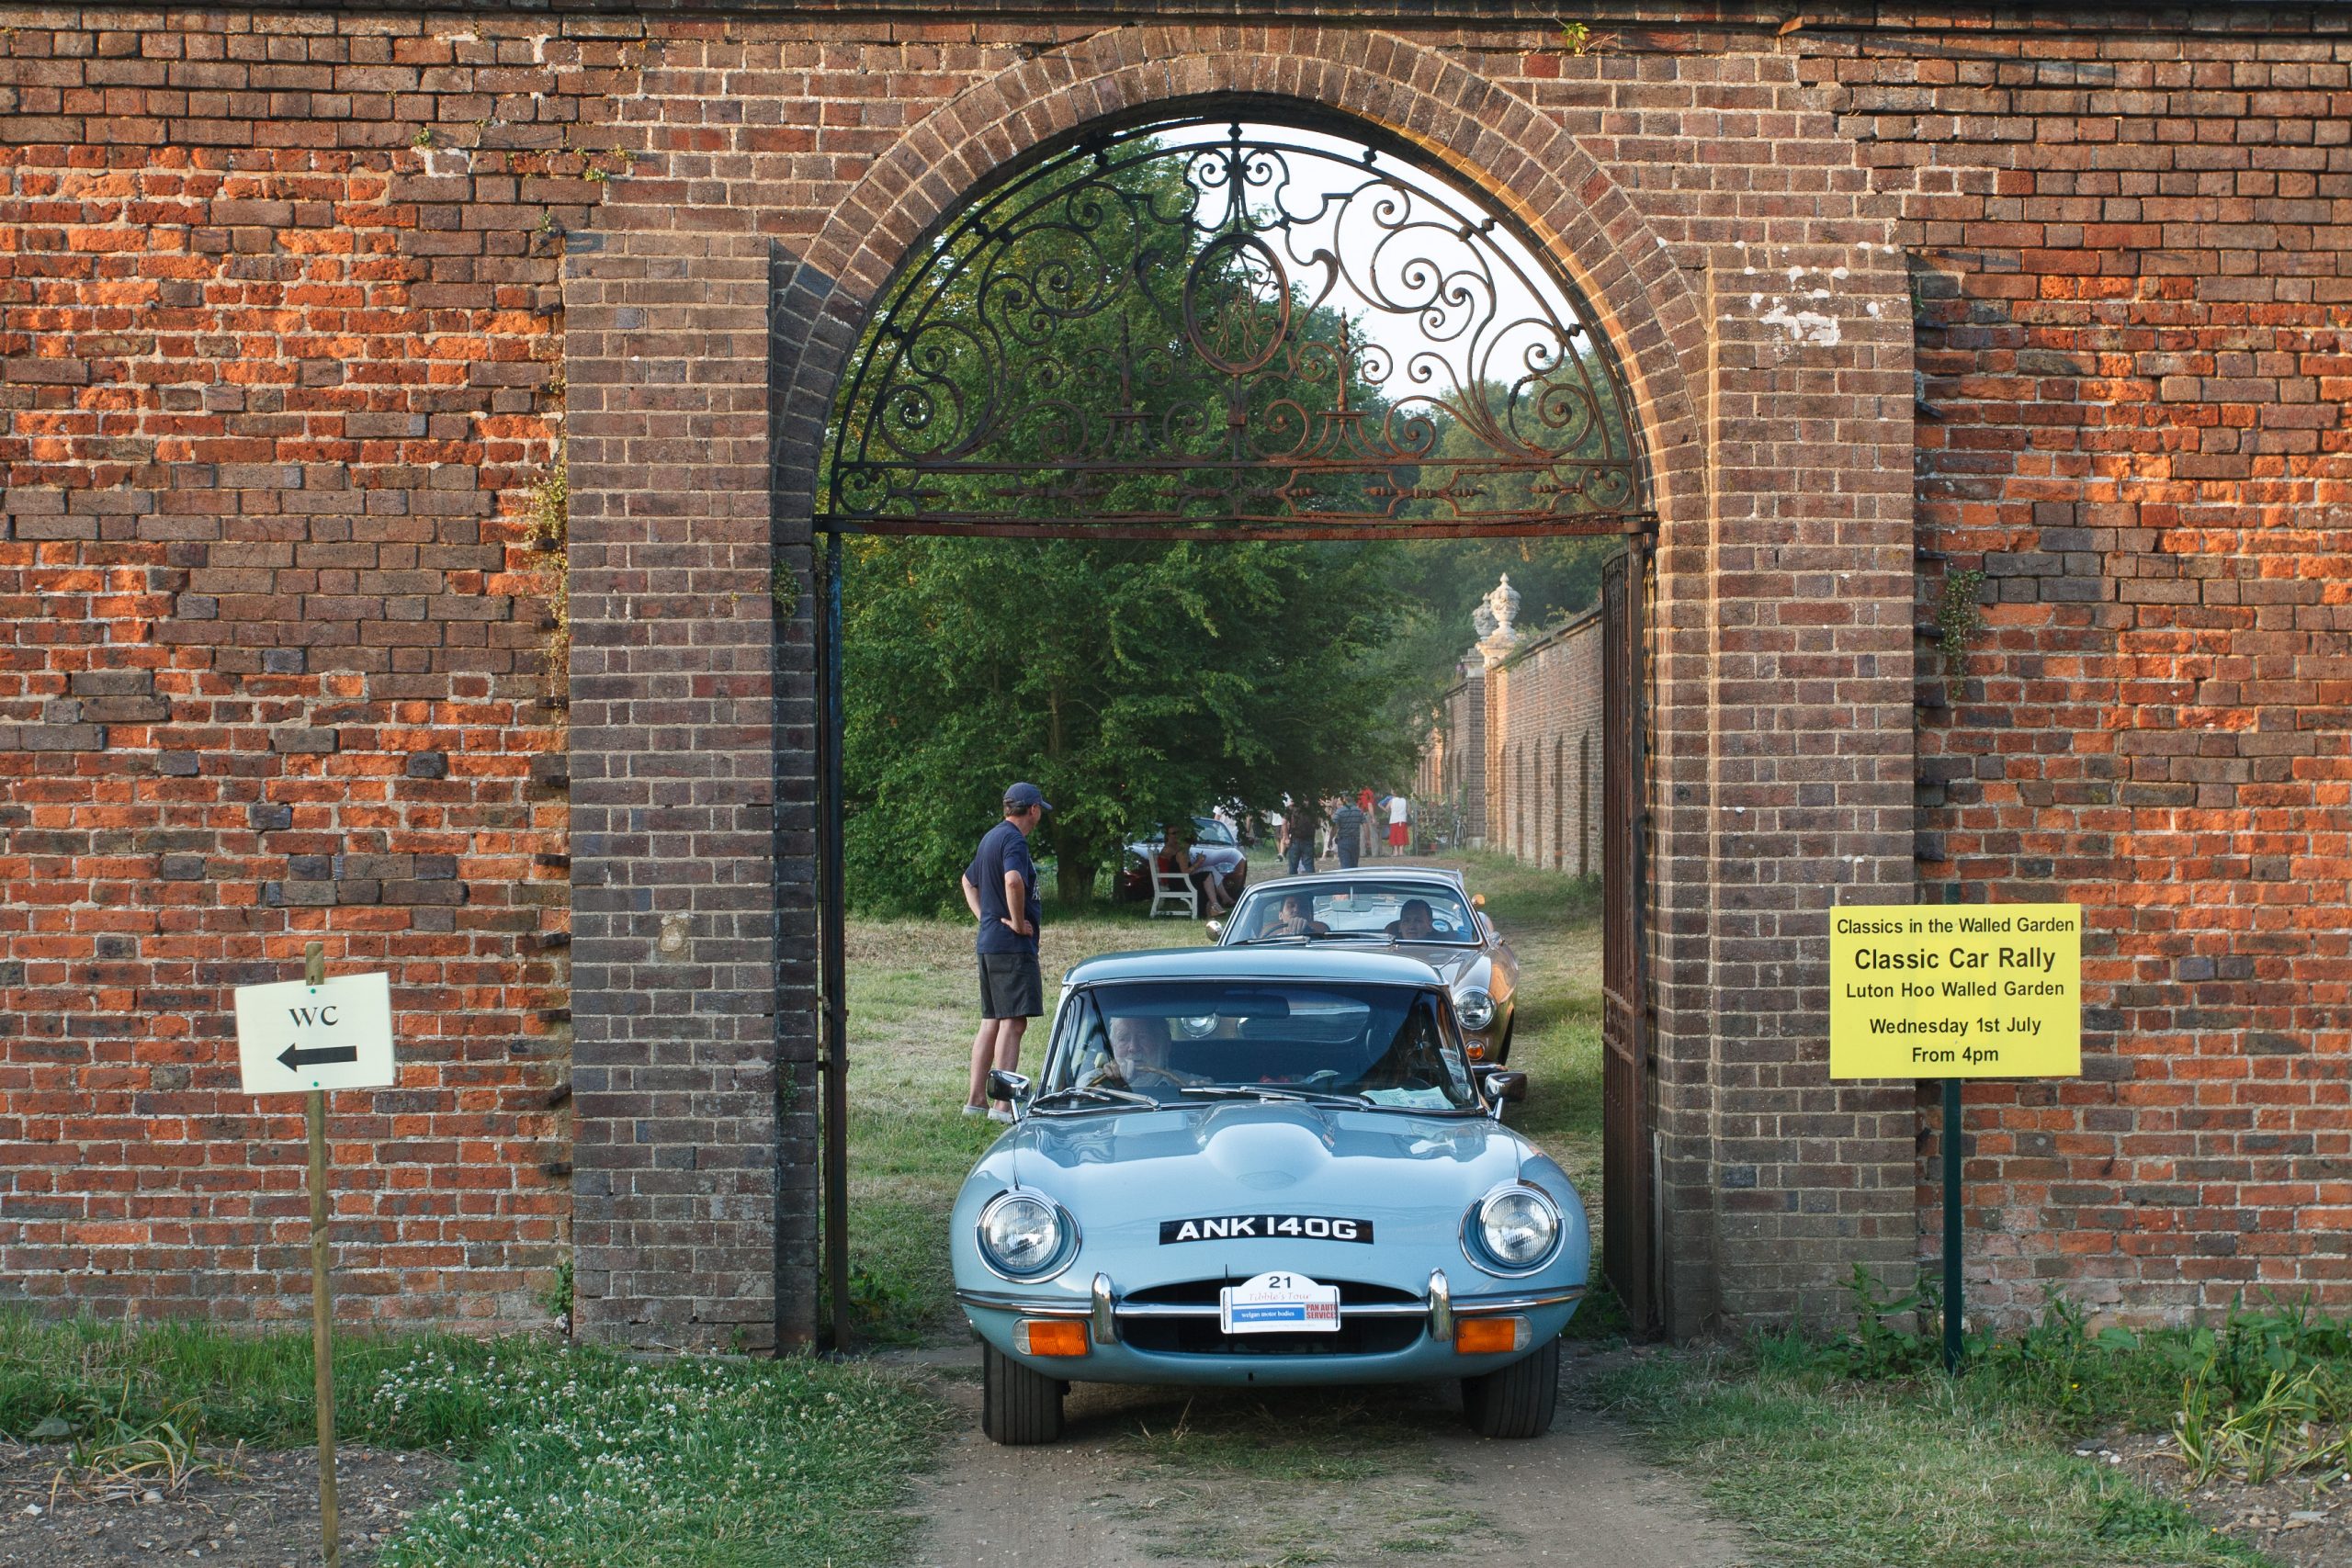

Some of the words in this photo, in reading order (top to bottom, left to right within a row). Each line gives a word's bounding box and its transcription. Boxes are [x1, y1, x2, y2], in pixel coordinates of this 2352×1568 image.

[1838, 919, 1903, 933] Classics
[1909, 919, 1923, 932] in
[1929, 919, 1953, 932] the
[1960, 918, 2010, 932] Walled
[2017, 918, 2074, 931] Garden
[1855, 949, 1939, 969] Classic
[1950, 948, 1989, 968] Car
[1999, 947, 2055, 972] Rally
[1847, 983, 1894, 998] Luton
[1902, 983, 1934, 997] Hoo
[1942, 982, 1996, 996] Walled
[2004, 981, 2064, 996] Garden
[288, 1006, 338, 1027] WC
[1870, 1018, 1968, 1036] Wednesday
[1976, 1018, 1999, 1032] 1st
[2007, 1017, 2041, 1035] July
[1912, 1048, 1954, 1063] From
[1962, 1047, 1998, 1065] 4pm
[1176, 1217, 1256, 1240] ANK
[1268, 1217, 1357, 1239] 140G
[1269, 1277, 1291, 1288] 21
